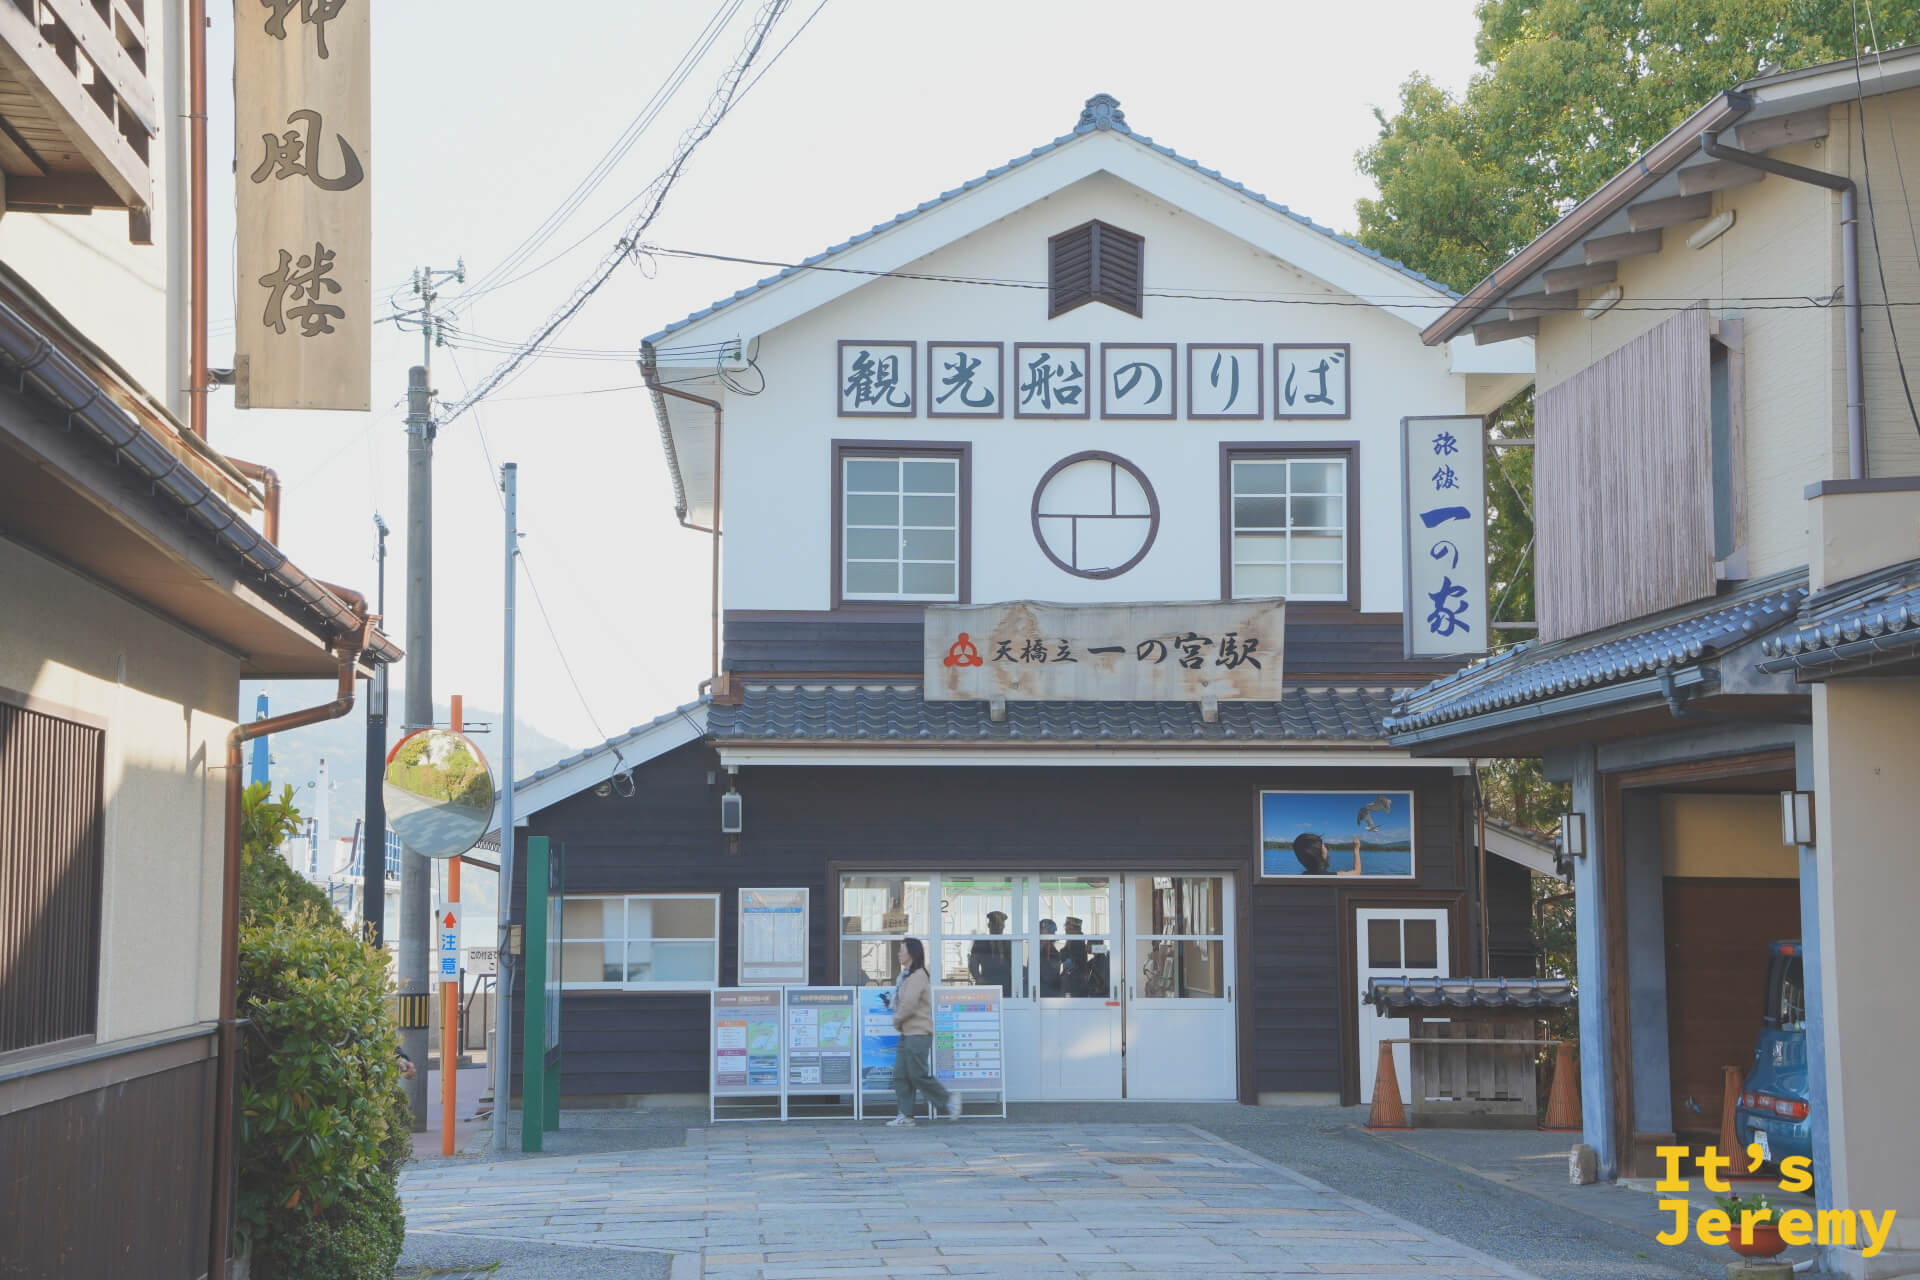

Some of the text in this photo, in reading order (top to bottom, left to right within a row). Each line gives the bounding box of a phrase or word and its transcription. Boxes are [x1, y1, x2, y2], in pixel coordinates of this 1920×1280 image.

[843, 350, 1345, 412] 観光船のりば
[441, 933, 457, 975] 注意
